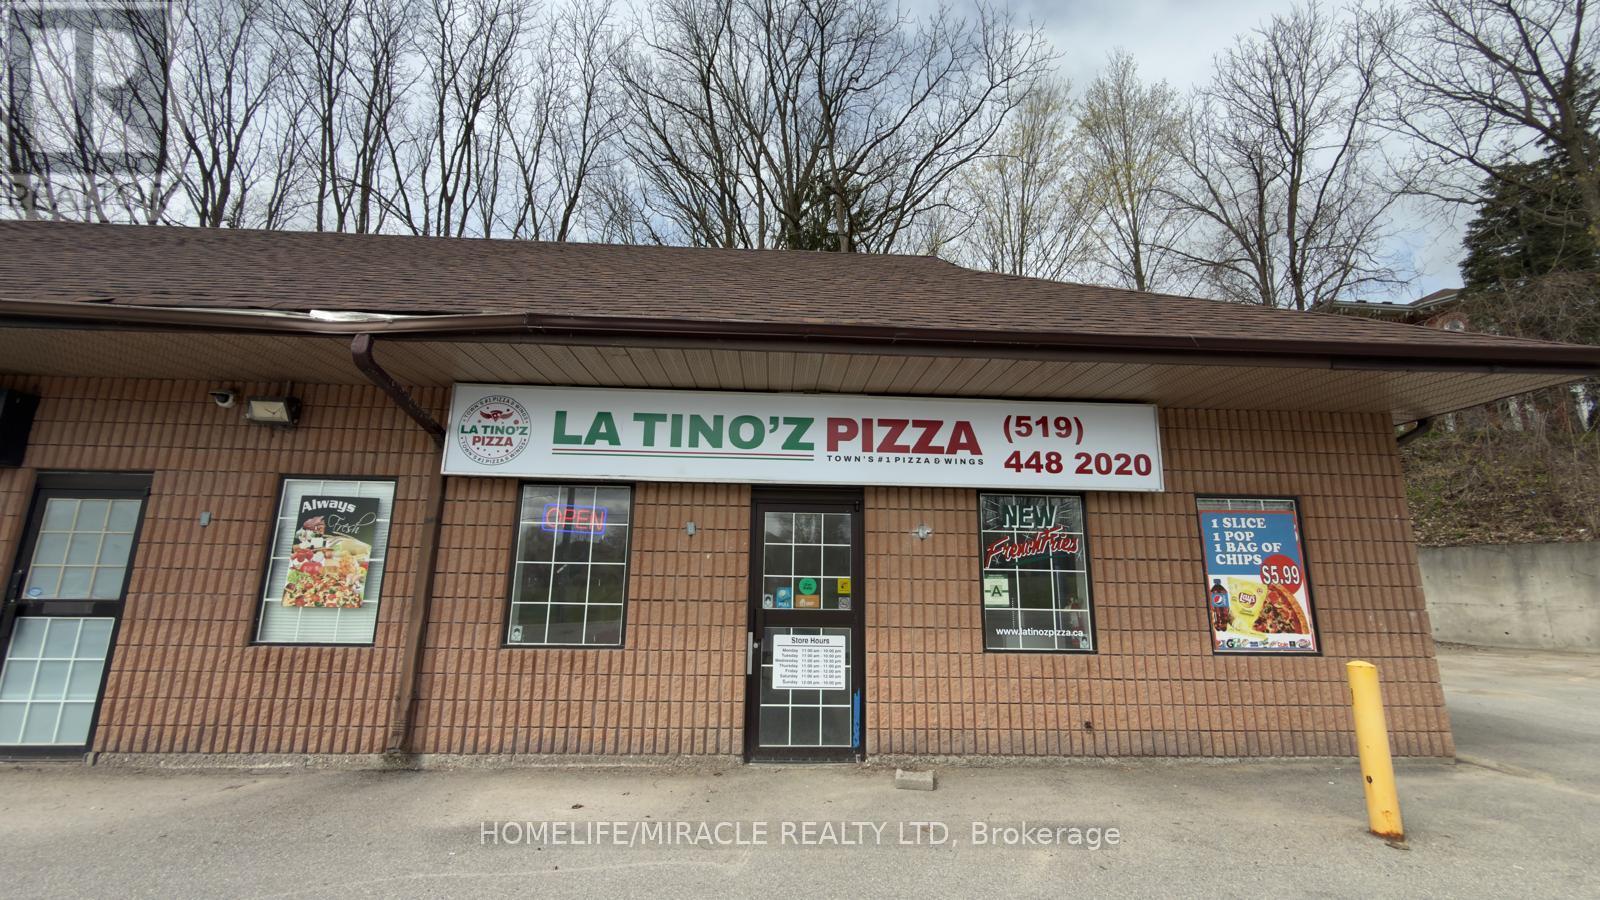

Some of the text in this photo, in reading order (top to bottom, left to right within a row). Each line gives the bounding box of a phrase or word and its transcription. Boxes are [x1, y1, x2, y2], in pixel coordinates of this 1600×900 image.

[460, 425, 528, 436] LA TINO'Z
[552, 410, 983, 455] LA TINO'Z PIZZA
[1003, 414, 1084, 445] (519)
[472, 436, 514, 447] PIZZA
[827, 455, 874, 463] TOWN'S
[944, 457, 984, 466] WINGS
[1004, 450, 1152, 476] 448 2020
[302, 499, 357, 514] Always
[546, 507, 605, 531] OPEN
[1002, 503, 1058, 529] NEW
[327, 511, 377, 534] Fresh
[1211, 517, 1267, 529] 1 SLICE
[1213, 531, 1255, 542] 1 POP
[1214, 542, 1283, 553] 1 BAG OF
[1215, 553, 1263, 565] CHIPS
[1262, 565, 1300, 585] $5.99
[992, 585, 1002, 597] A
[791, 636, 830, 645] Store Hours
